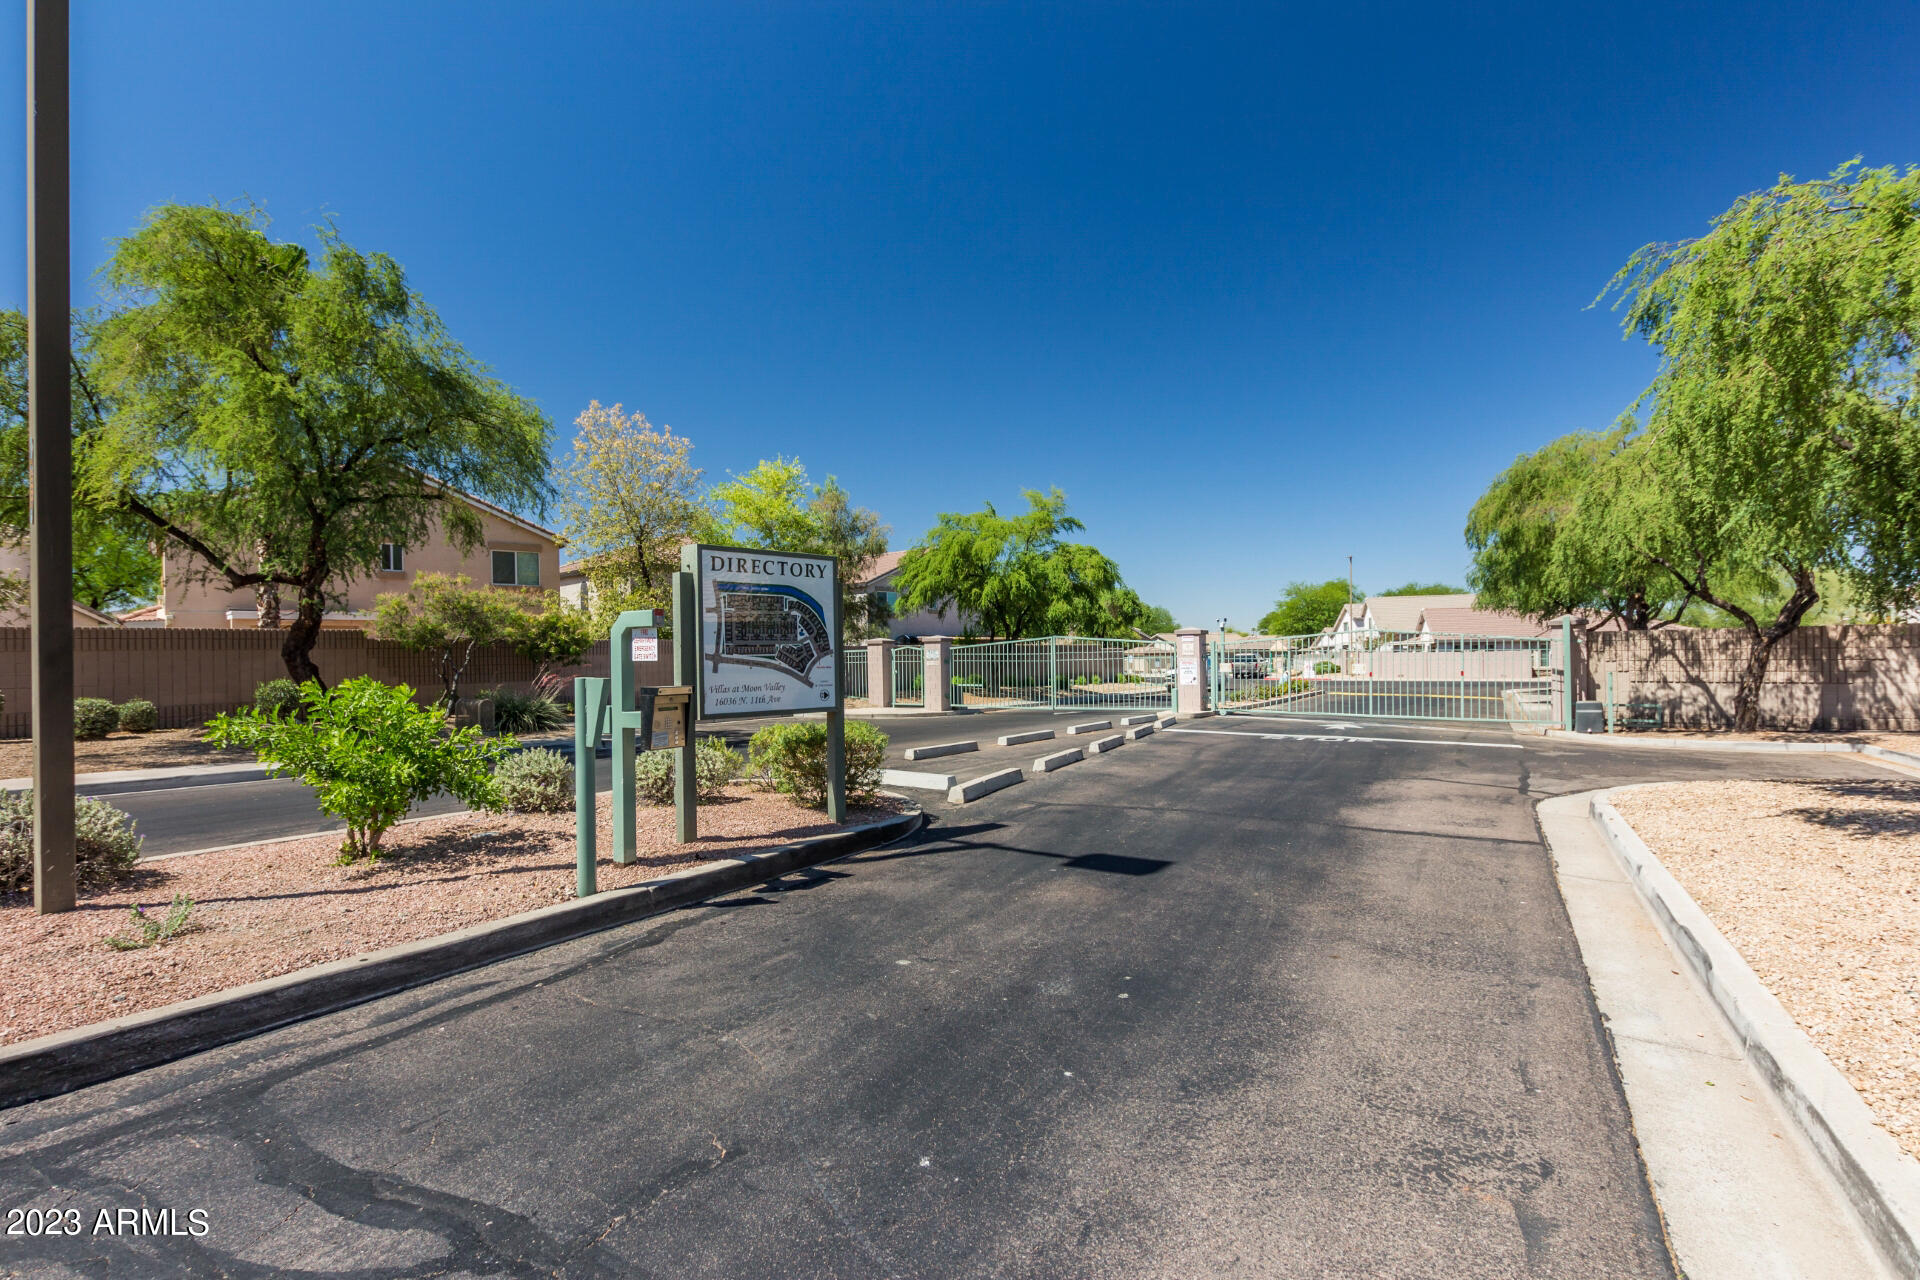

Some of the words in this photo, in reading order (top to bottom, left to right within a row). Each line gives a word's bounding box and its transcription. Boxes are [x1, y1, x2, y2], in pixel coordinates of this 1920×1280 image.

[710, 555, 827, 579] DIRECTORY
[709, 684, 730, 694] Villas
[740, 684, 762, 693] Moon
[764, 682, 786, 694] Valley
[715, 696, 737, 706] 16036
[738, 696, 748, 705] N.
[750, 695, 766, 705] 11th
[766, 695, 782, 705] Ave
